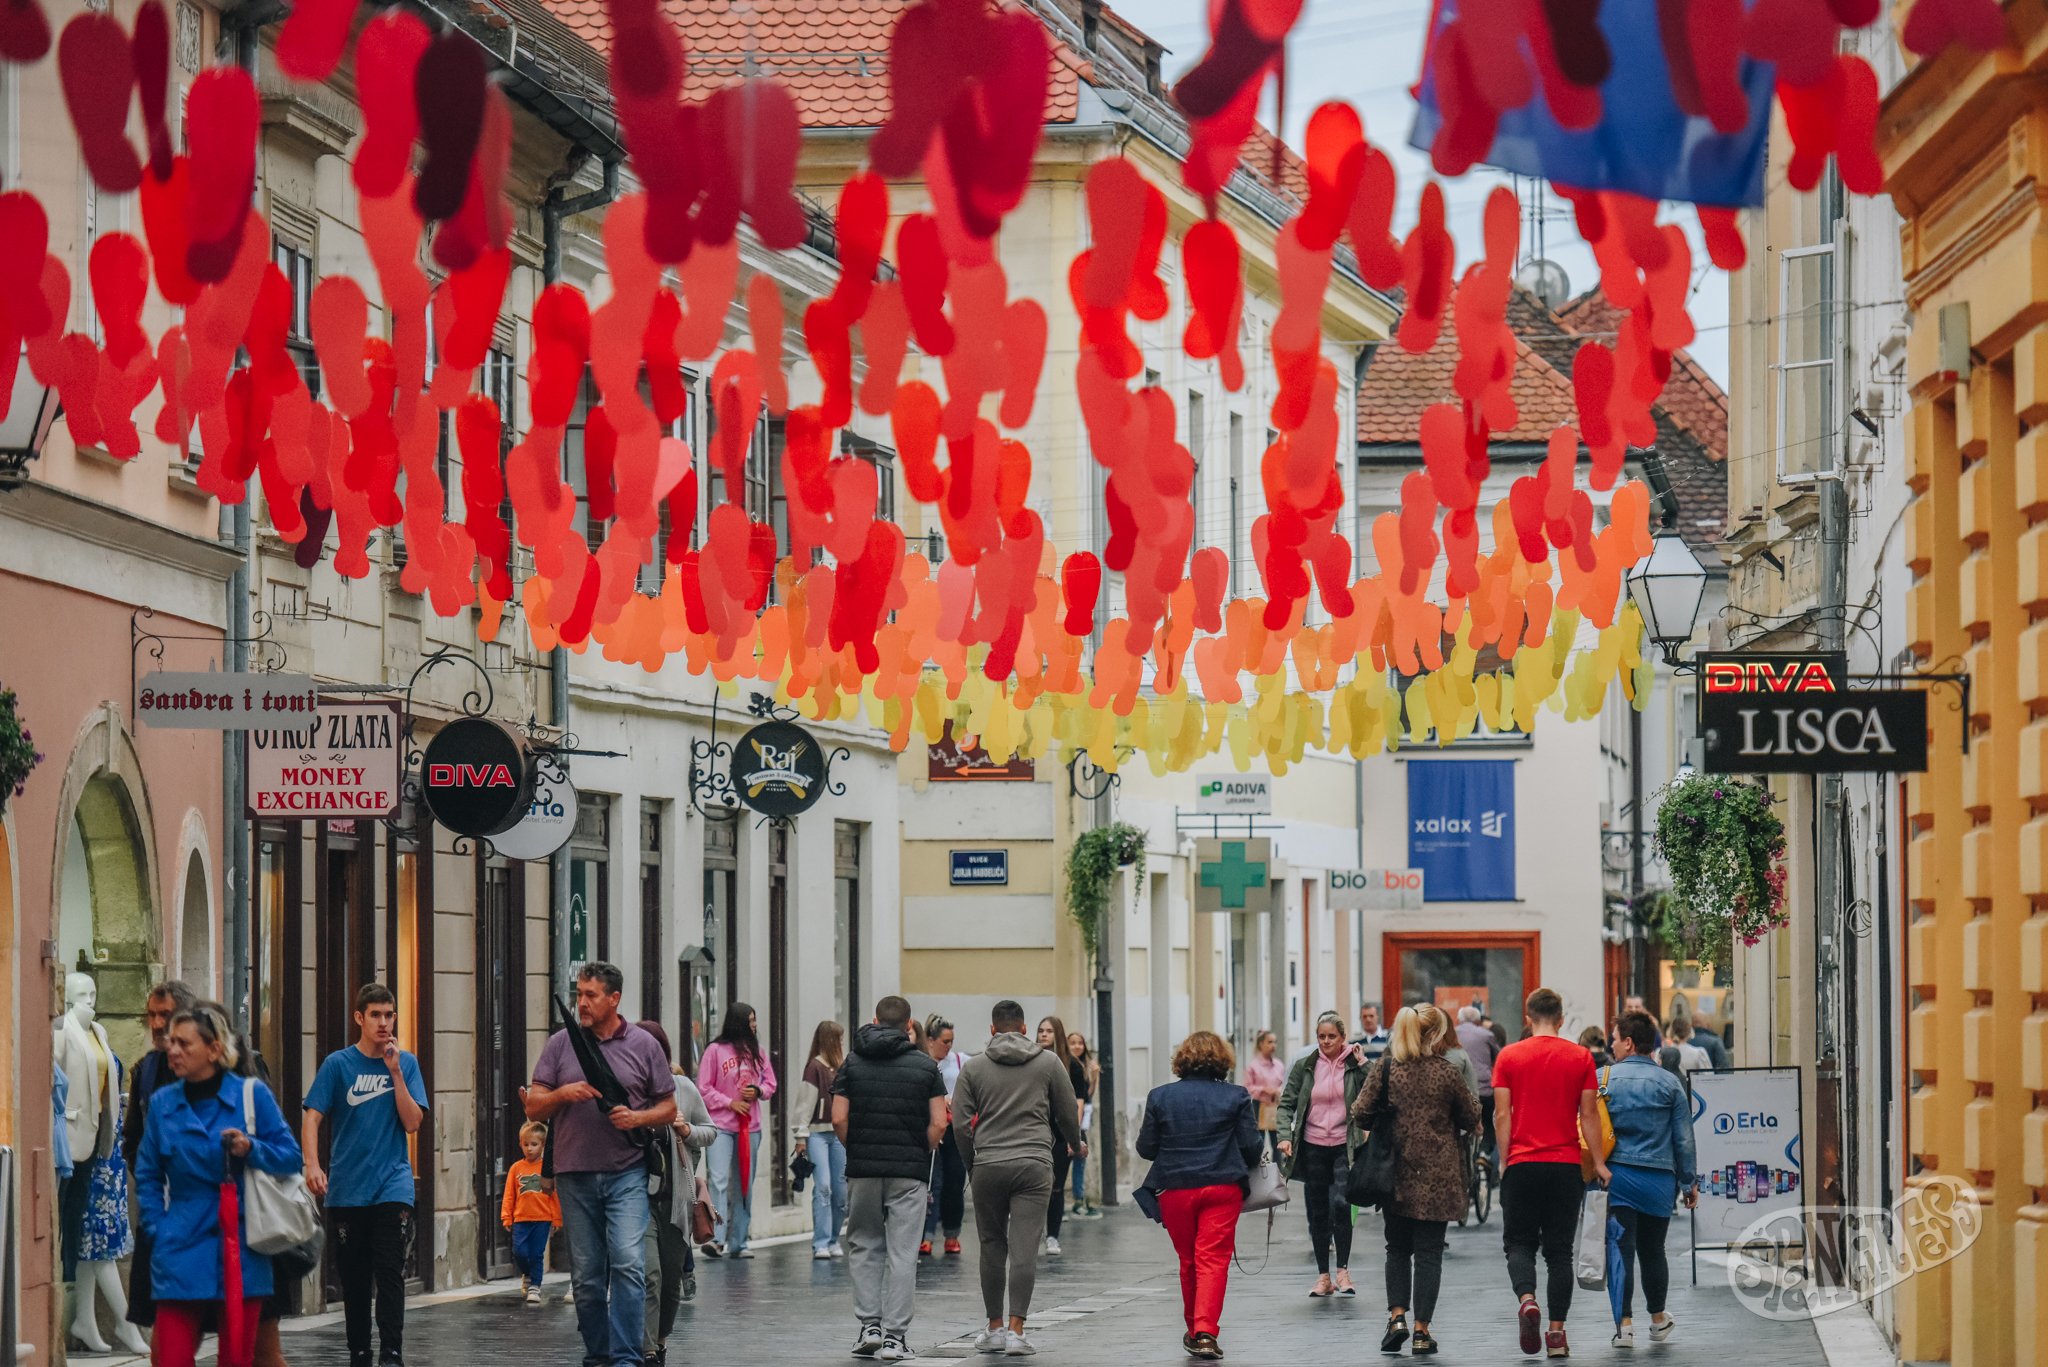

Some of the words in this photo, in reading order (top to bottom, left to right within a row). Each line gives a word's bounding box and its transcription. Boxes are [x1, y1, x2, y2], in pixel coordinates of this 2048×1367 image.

[1705, 662, 1837, 693] DIVA
[139, 688, 234, 711] sandra
[243, 688, 252, 711] i
[262, 689, 316, 712] toni
[327, 715, 393, 749] ZLATA
[1737, 706, 1897, 755] LISCA
[760, 744, 796, 776] Raj
[281, 768, 366, 786] MONEY
[429, 763, 516, 787] DIVA
[1226, 783, 1266, 795] ADIVA
[257, 791, 389, 810] EXCHANGE
[526, 798, 564, 817] rla
[1415, 816, 1472, 833] xalax
[1331, 869, 1367, 889] bio
[353, 1074, 390, 1092] NIKE
[1737, 1112, 1778, 1128] Erla
